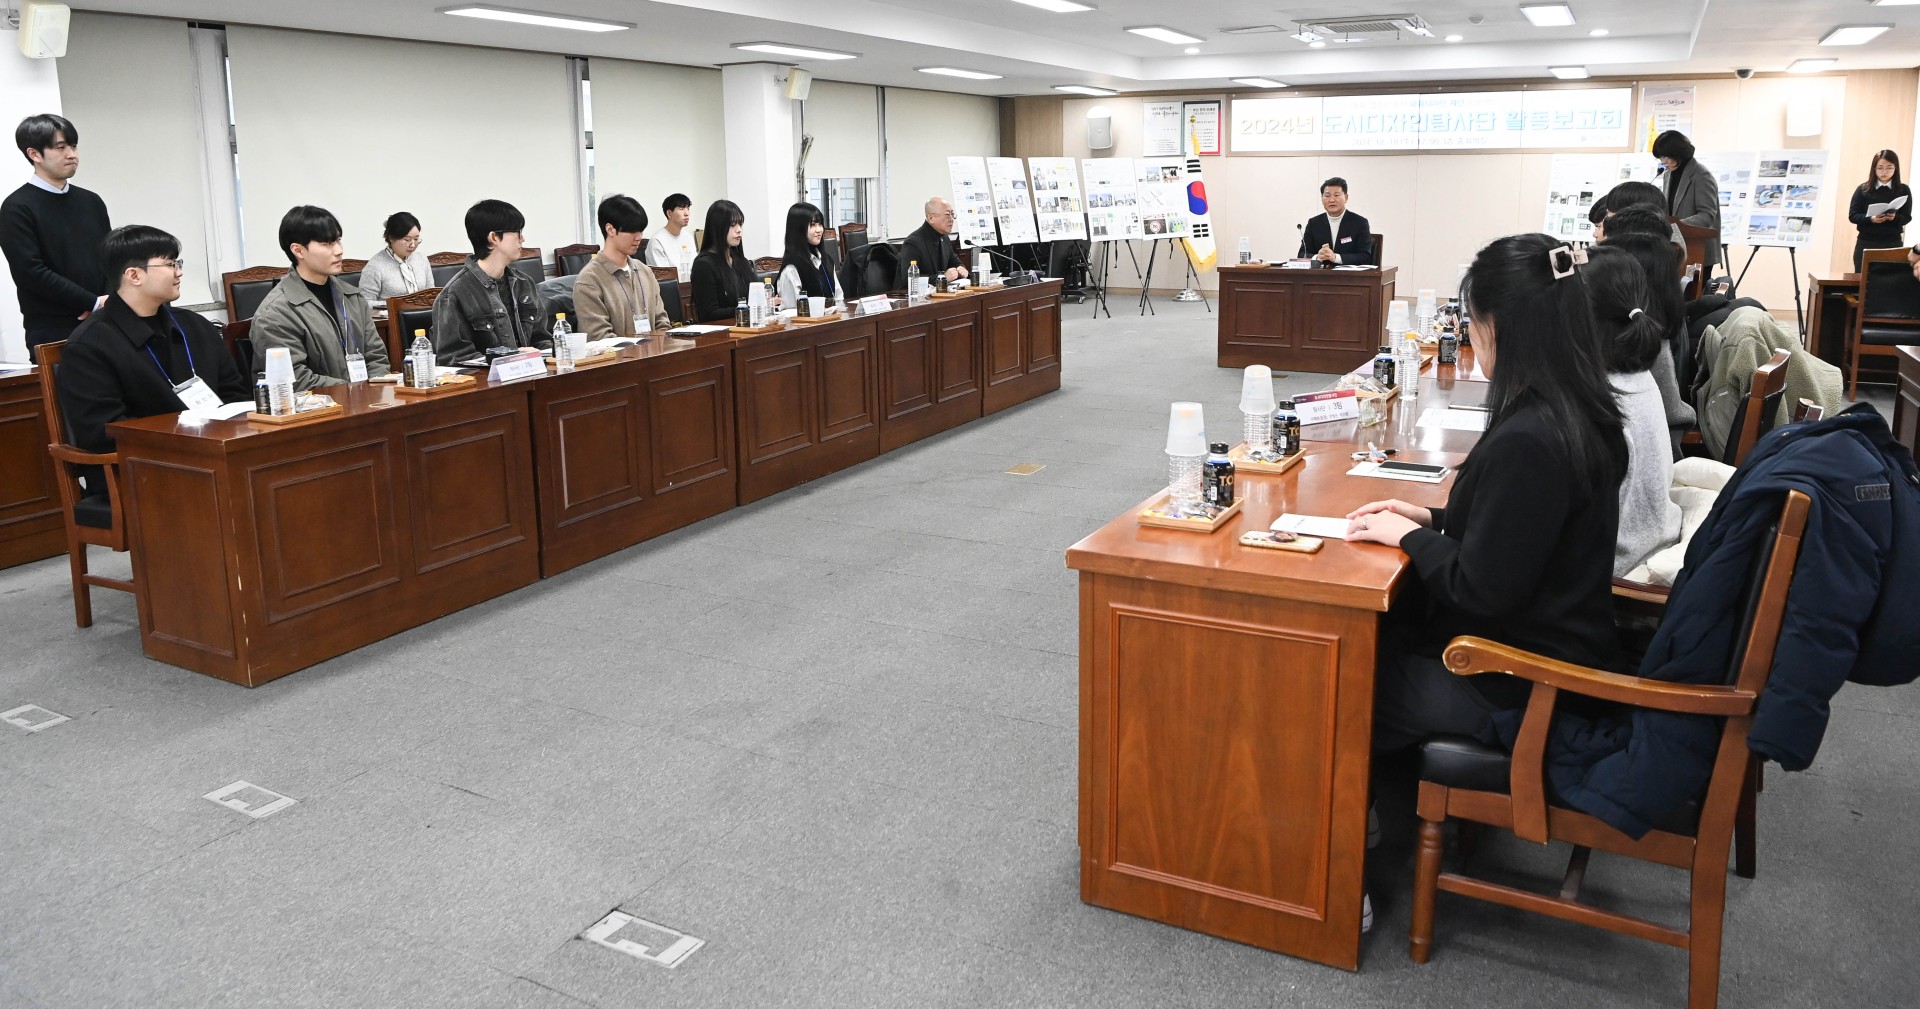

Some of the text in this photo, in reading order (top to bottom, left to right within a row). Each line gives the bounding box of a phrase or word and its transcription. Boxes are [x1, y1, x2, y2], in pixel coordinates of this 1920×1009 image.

[1241, 109, 1621, 135] 2024년 도시디자인탐사단 활동보고회
